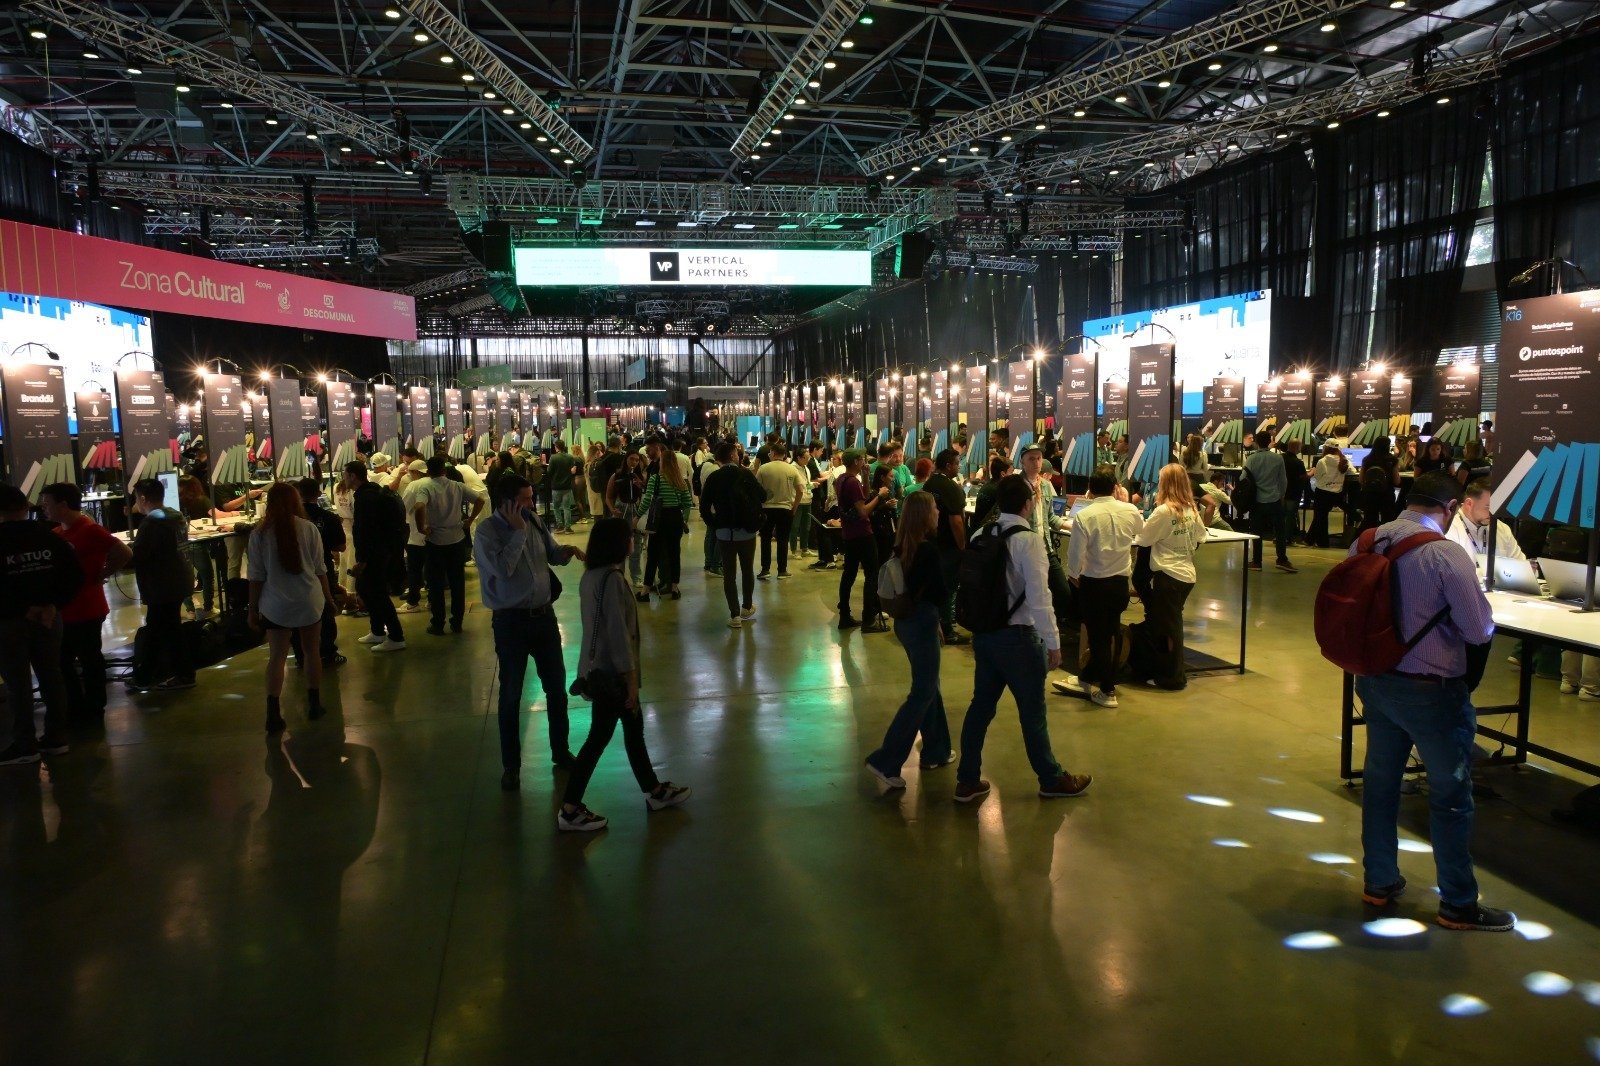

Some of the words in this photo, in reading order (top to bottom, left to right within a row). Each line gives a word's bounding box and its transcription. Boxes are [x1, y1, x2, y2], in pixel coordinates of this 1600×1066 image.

[687, 256, 745, 265] VERTICAL
[656, 261, 673, 272] VP
[688, 268, 749, 277] PARTNERS
[118, 261, 172, 294] Zona
[173, 271, 246, 305] Cultural
[303, 307, 356, 323] DESCOMUNAL
[1505, 310, 1522, 321] K16
[1532, 346, 1583, 359] puntospoint
